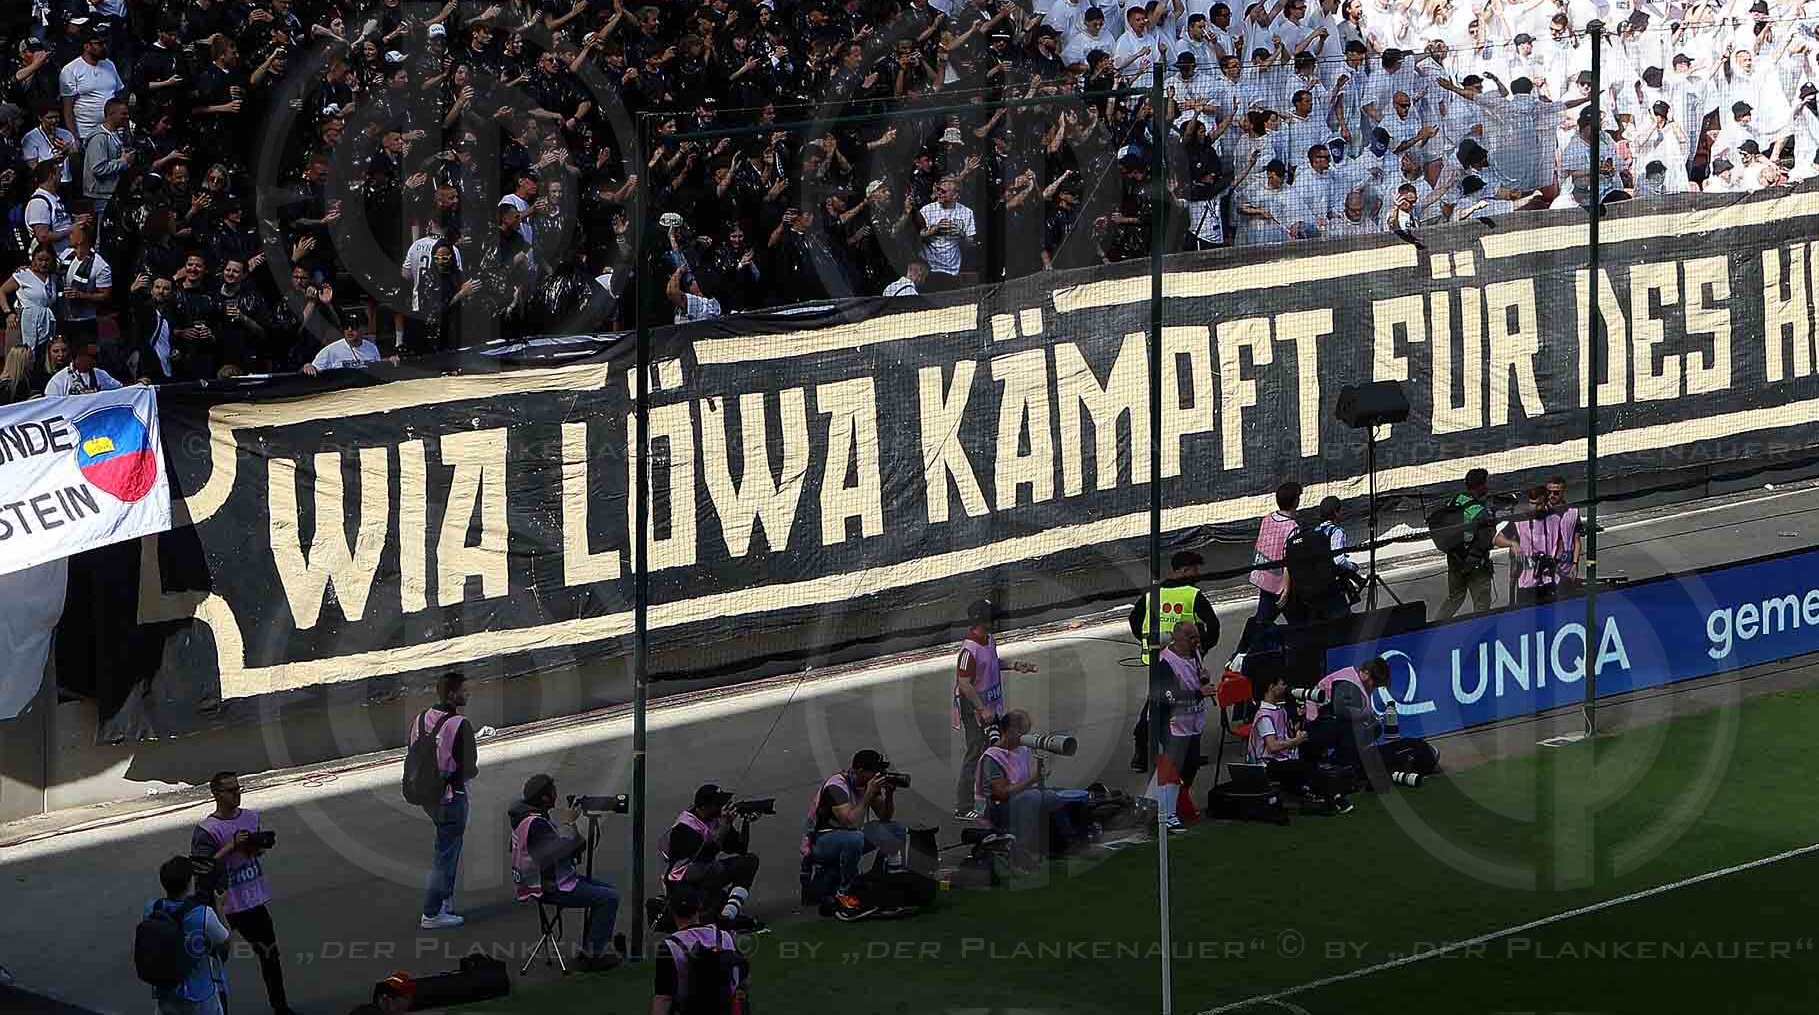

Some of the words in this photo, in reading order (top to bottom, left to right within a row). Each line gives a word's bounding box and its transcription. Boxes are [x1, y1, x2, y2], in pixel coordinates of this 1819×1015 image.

[267, 428, 509, 630] WIA
[562, 356, 884, 587] LÖWA
[917, 307, 1333, 524] KÄMPFT
[1372, 250, 1545, 442] FÜR
[1575, 255, 1732, 408] DES
[1450, 617, 1632, 705] UNIQA
